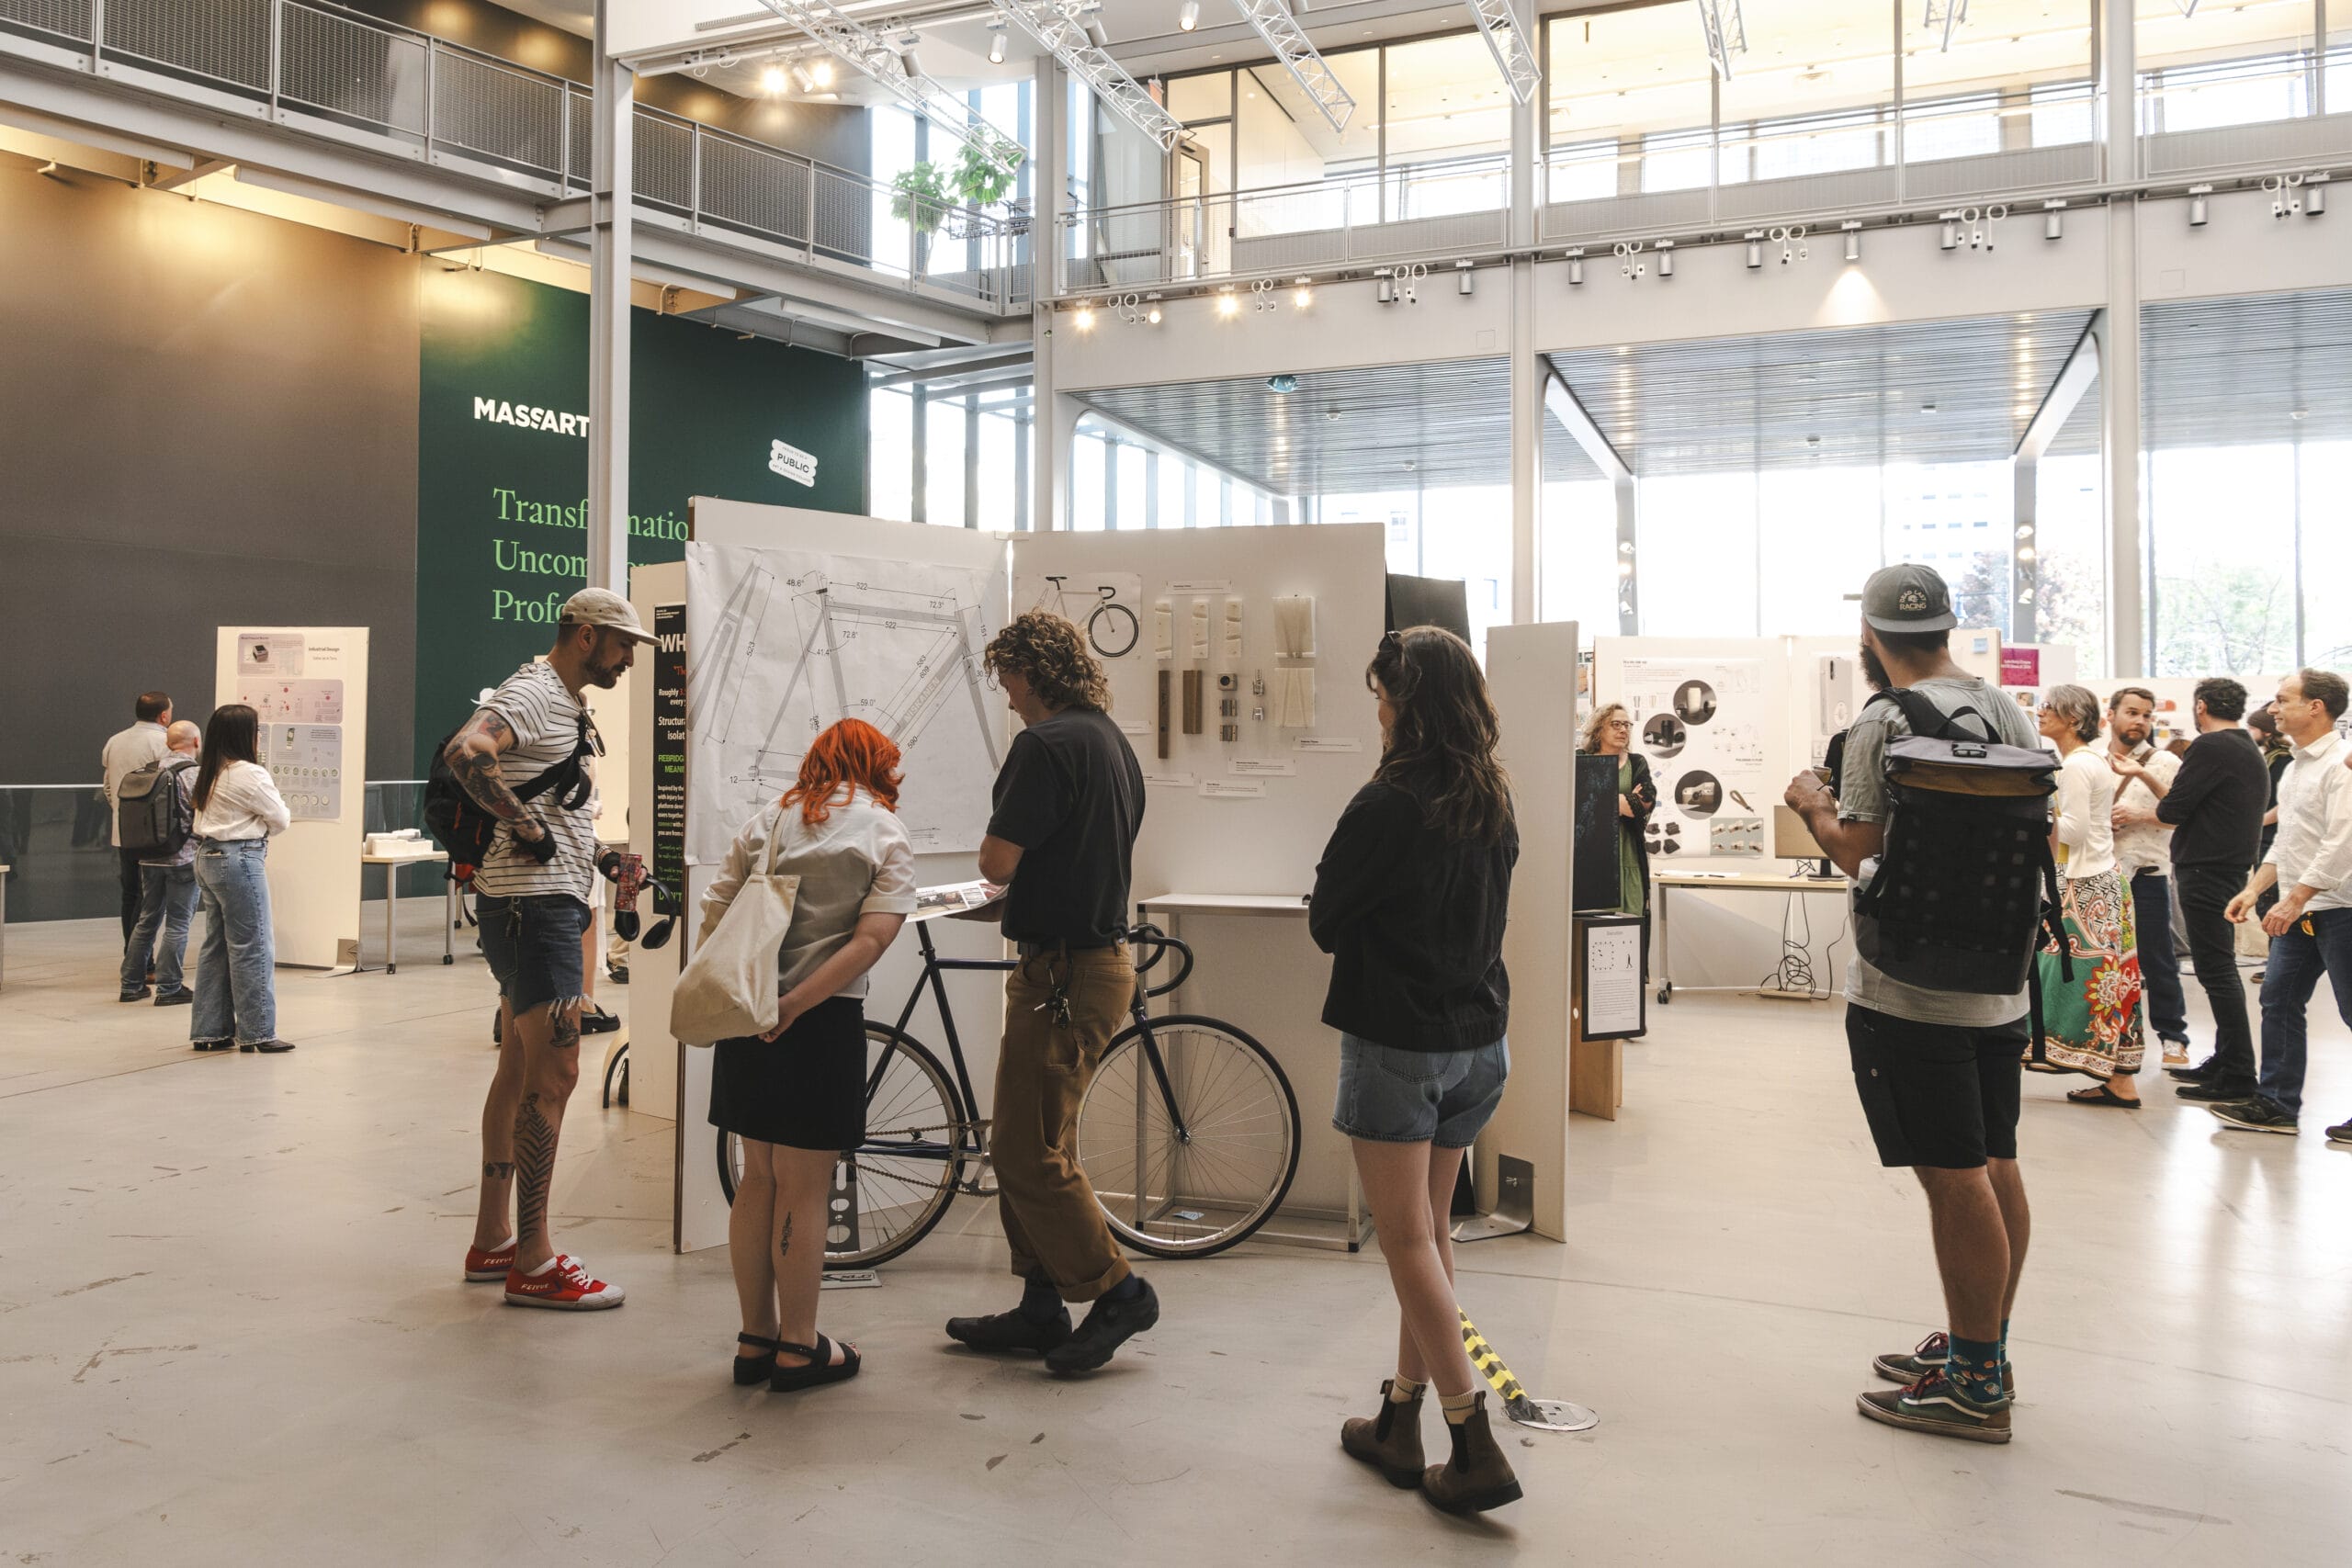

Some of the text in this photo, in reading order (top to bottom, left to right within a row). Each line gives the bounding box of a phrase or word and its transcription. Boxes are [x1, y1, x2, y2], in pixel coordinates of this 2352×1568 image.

[473, 396, 590, 438] MASSART
[777, 453, 809, 473] PUBLIC
[856, 581, 868, 591] 522
[885, 620, 897, 629] 522
[659, 688, 678, 697] Roughly
[908, 736, 918, 750] 590
